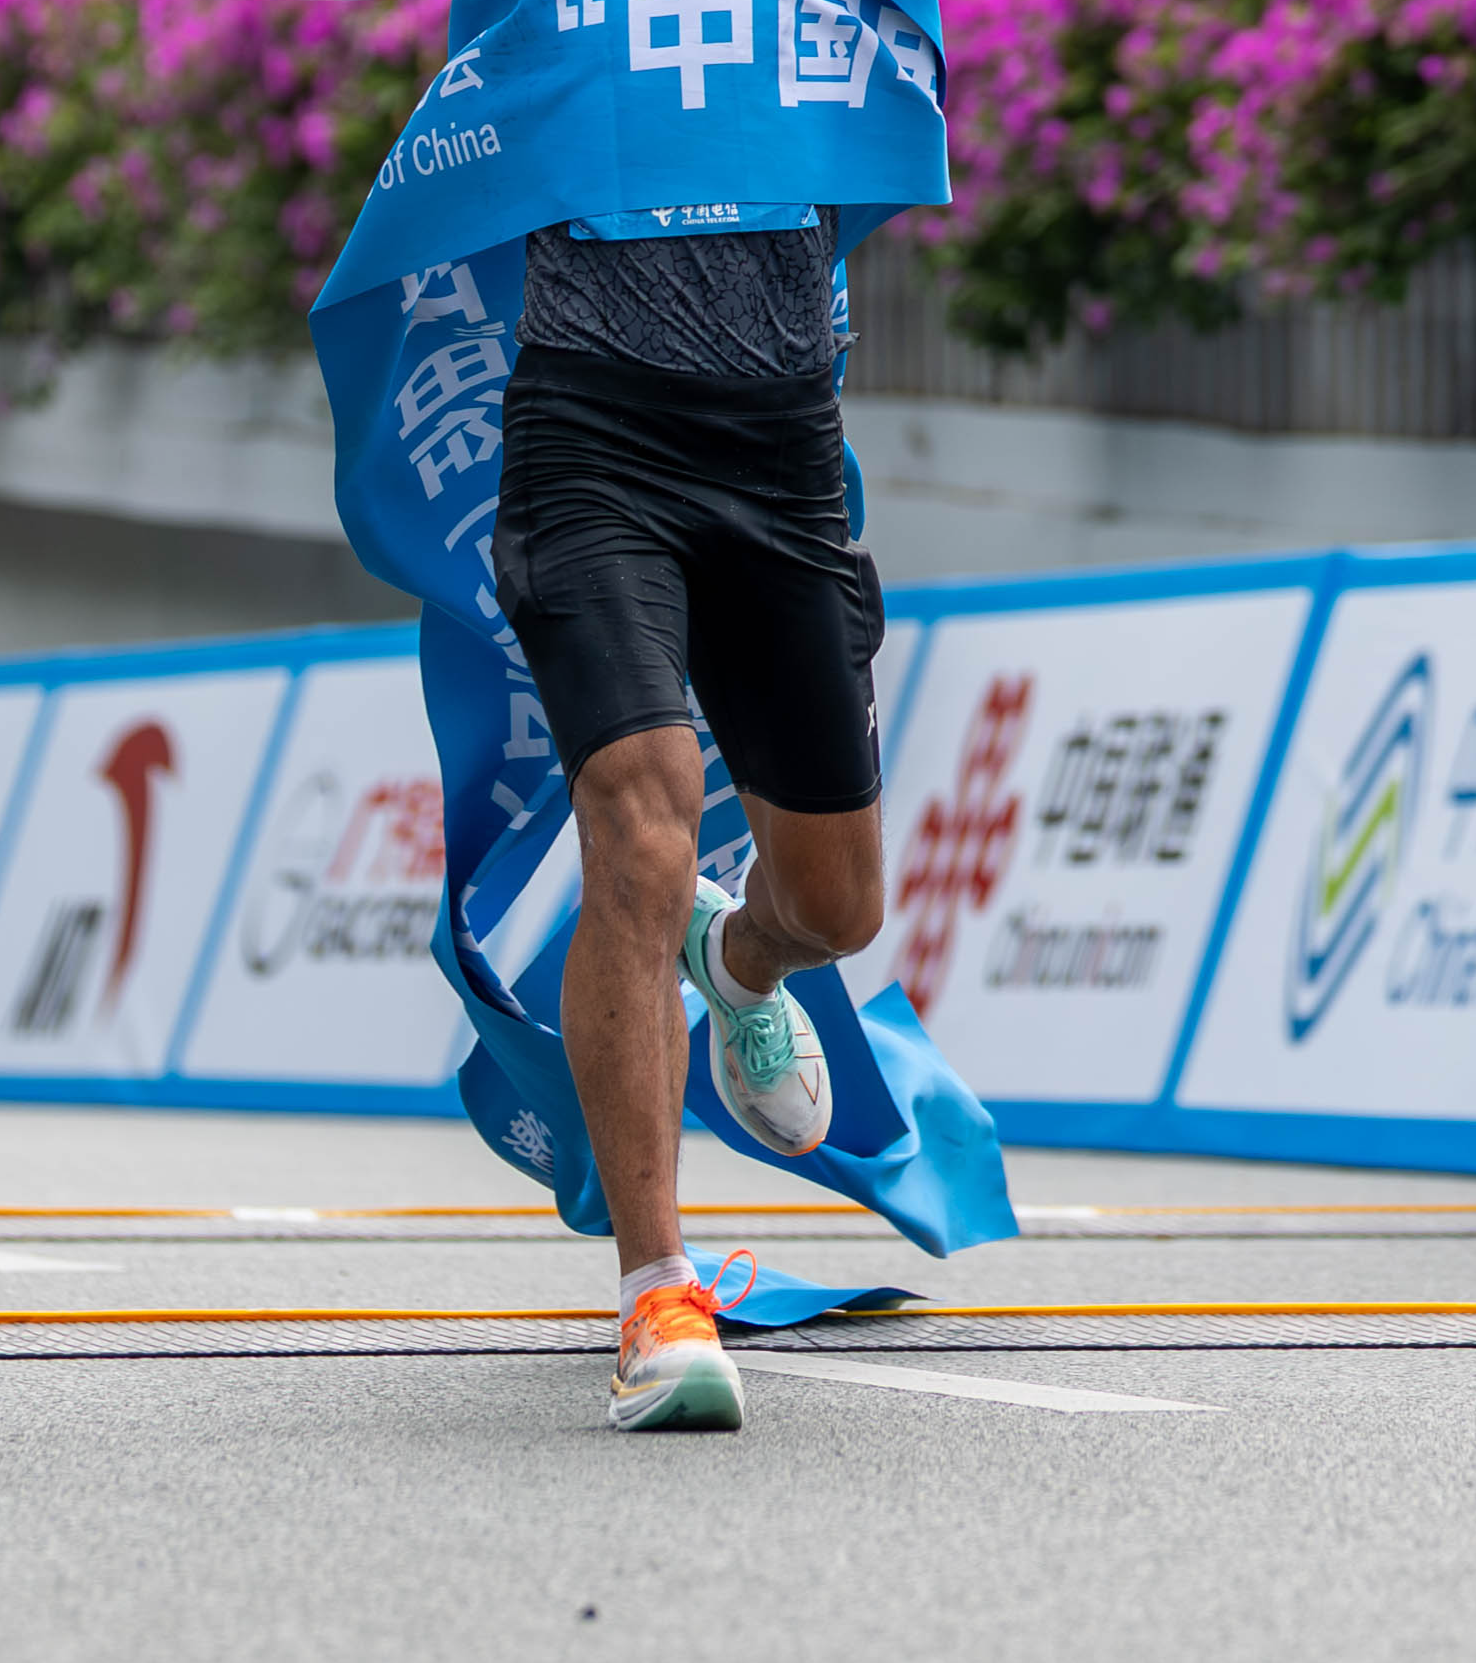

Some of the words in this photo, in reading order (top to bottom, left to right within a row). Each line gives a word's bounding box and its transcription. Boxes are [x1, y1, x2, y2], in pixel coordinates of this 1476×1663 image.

[412, 121, 502, 176] China
[681, 217, 705, 226] CHINA
[706, 215, 740, 225] TELECOM
